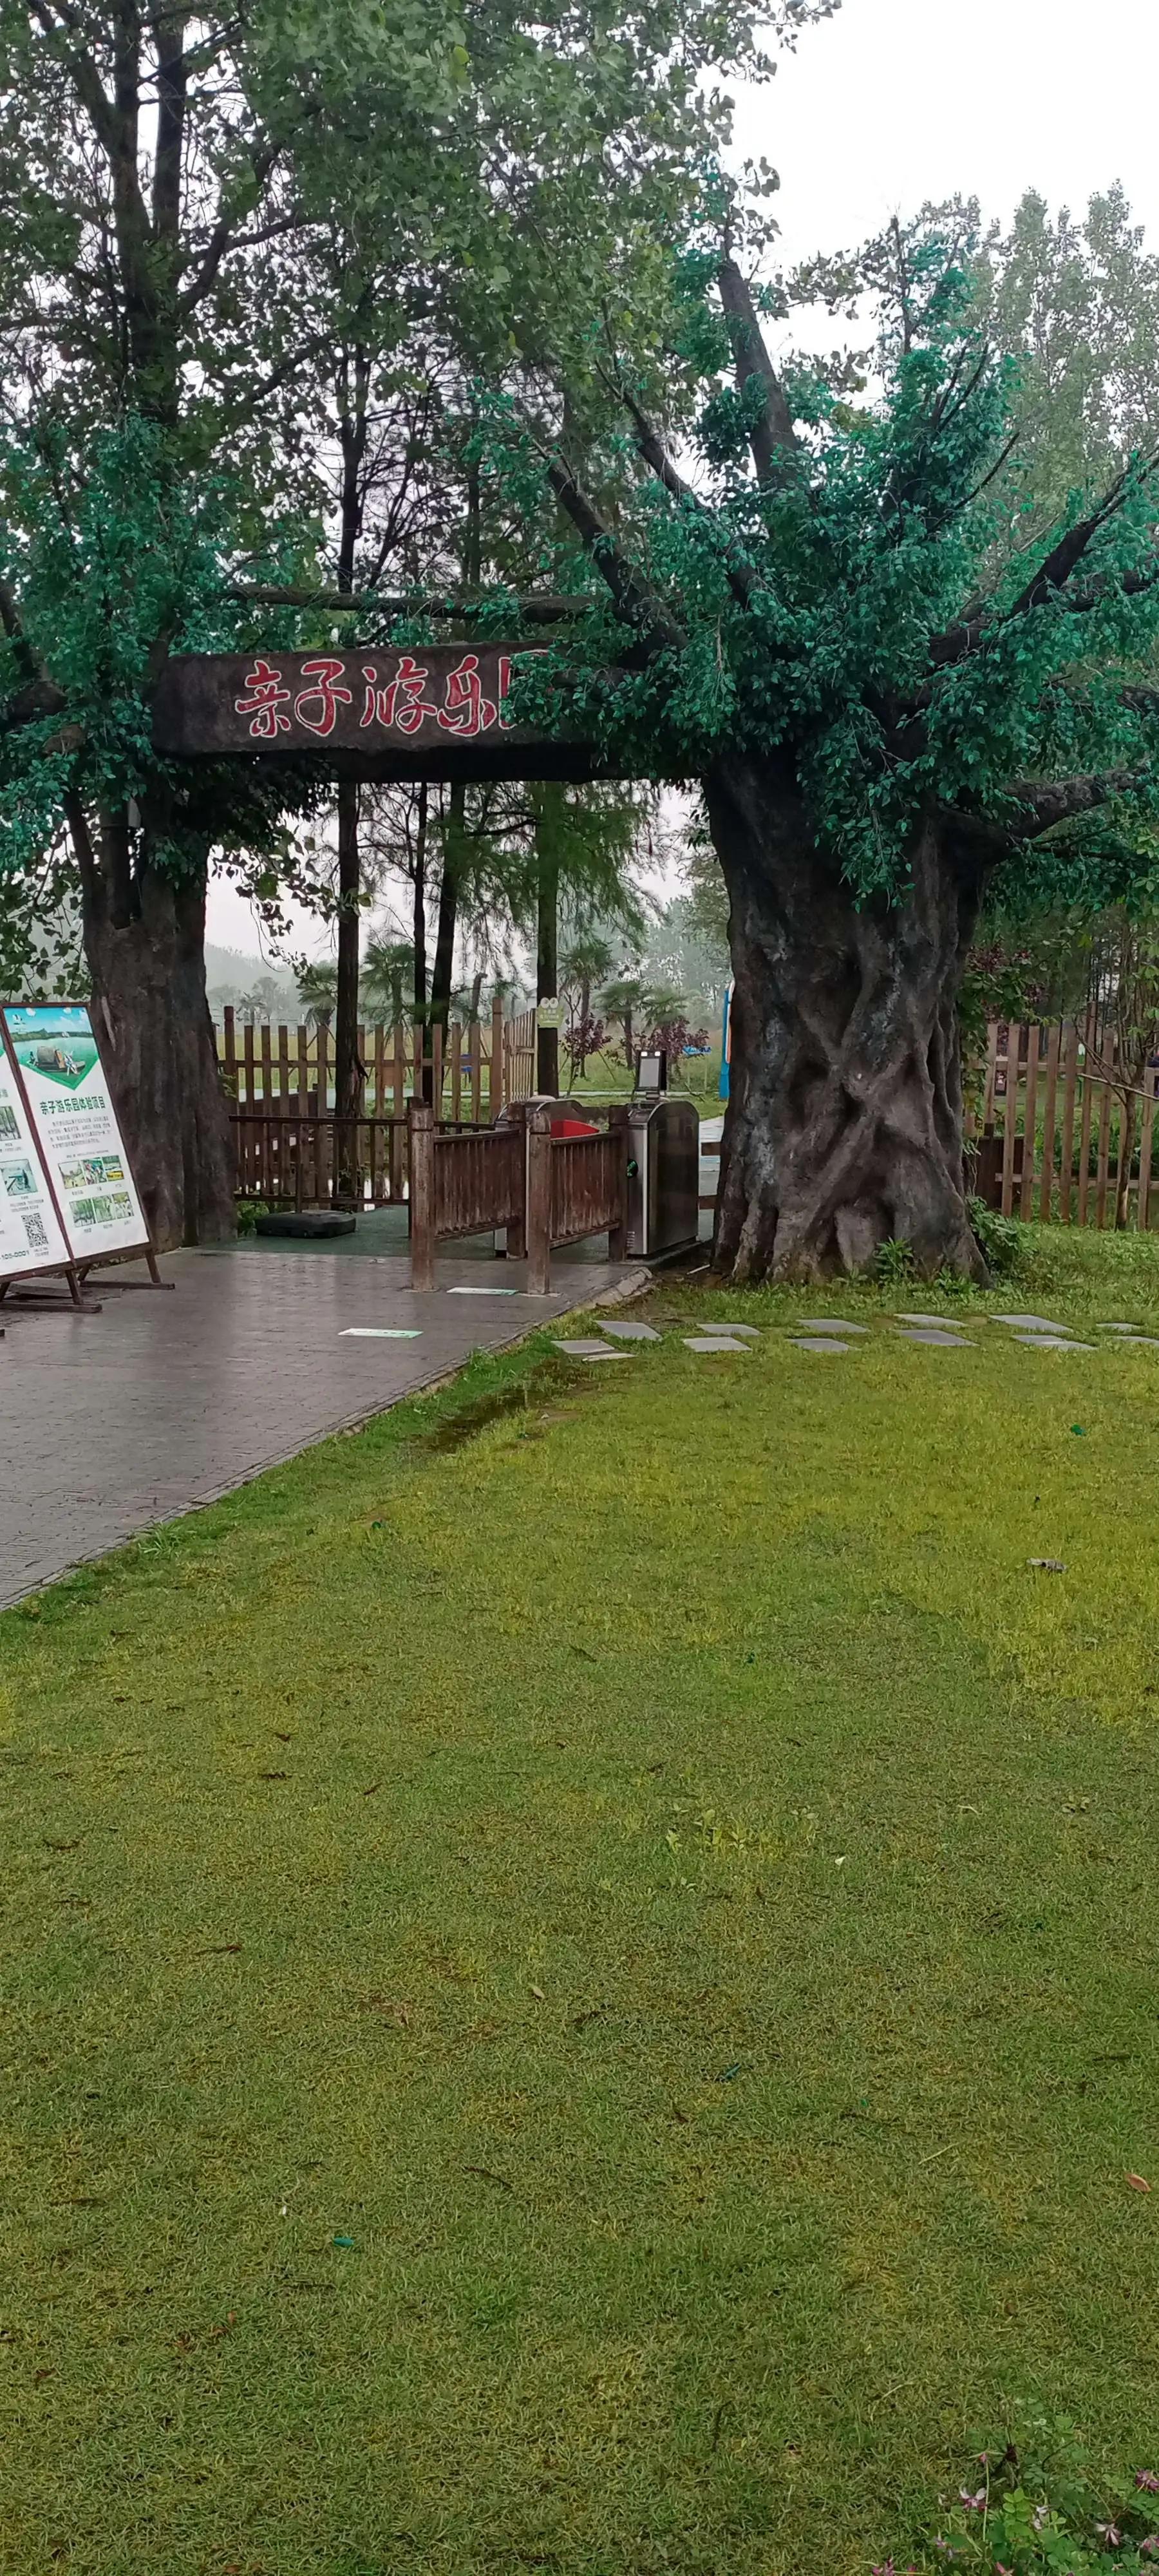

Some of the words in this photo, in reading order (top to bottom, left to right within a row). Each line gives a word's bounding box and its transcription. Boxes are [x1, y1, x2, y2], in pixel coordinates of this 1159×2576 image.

[39, 1096, 105, 1115] 亲子游乐园体验项目
